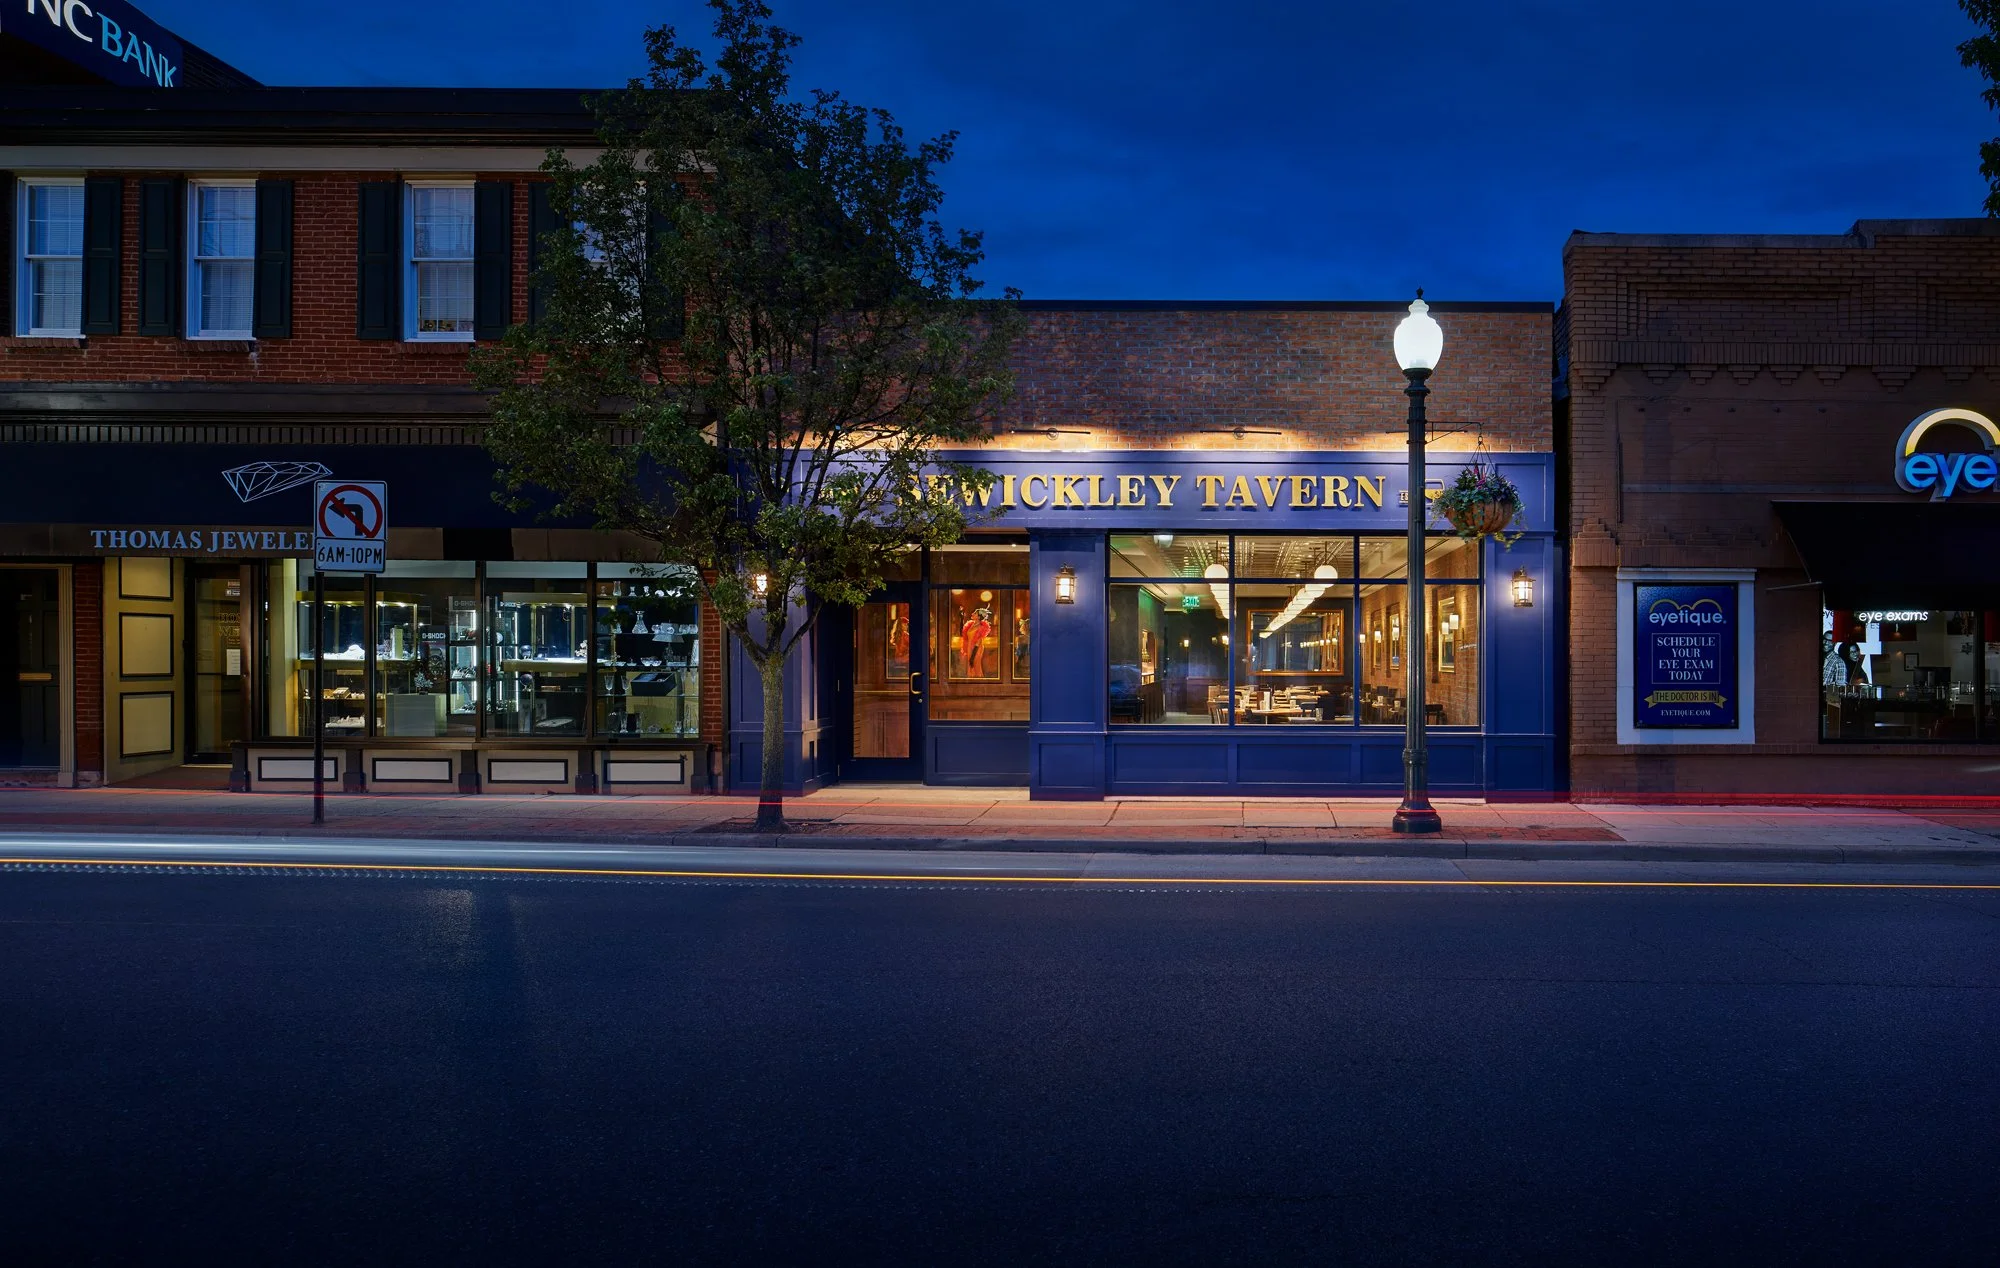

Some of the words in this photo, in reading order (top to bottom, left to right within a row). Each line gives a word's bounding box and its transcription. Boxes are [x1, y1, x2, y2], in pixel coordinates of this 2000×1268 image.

[97, 12, 177, 87] BANK
[1197, 475, 1386, 507] TAVERN
[91, 530, 201, 549] THOMAS
[207, 531, 314, 552] JEWELE
[318, 546, 382, 565] 6AM-10PM
[1859, 612, 1883, 623] eye
[1886, 611, 1929, 621] exams
[1657, 636, 1715, 646] SCHEDULE
[1672, 648, 1701, 658] YOUR
[1659, 659, 1680, 669] EYE
[1684, 659, 1714, 669] EXAM
[1669, 670, 1704, 681] TODAY
[1656, 691, 1669, 701] THE
[1670, 691, 1698, 701] DOCTOR
[1700, 691, 1708, 701] IS
[1709, 691, 1718, 701] IN
[1661, 709, 1711, 717] EYETIQUE.COM
